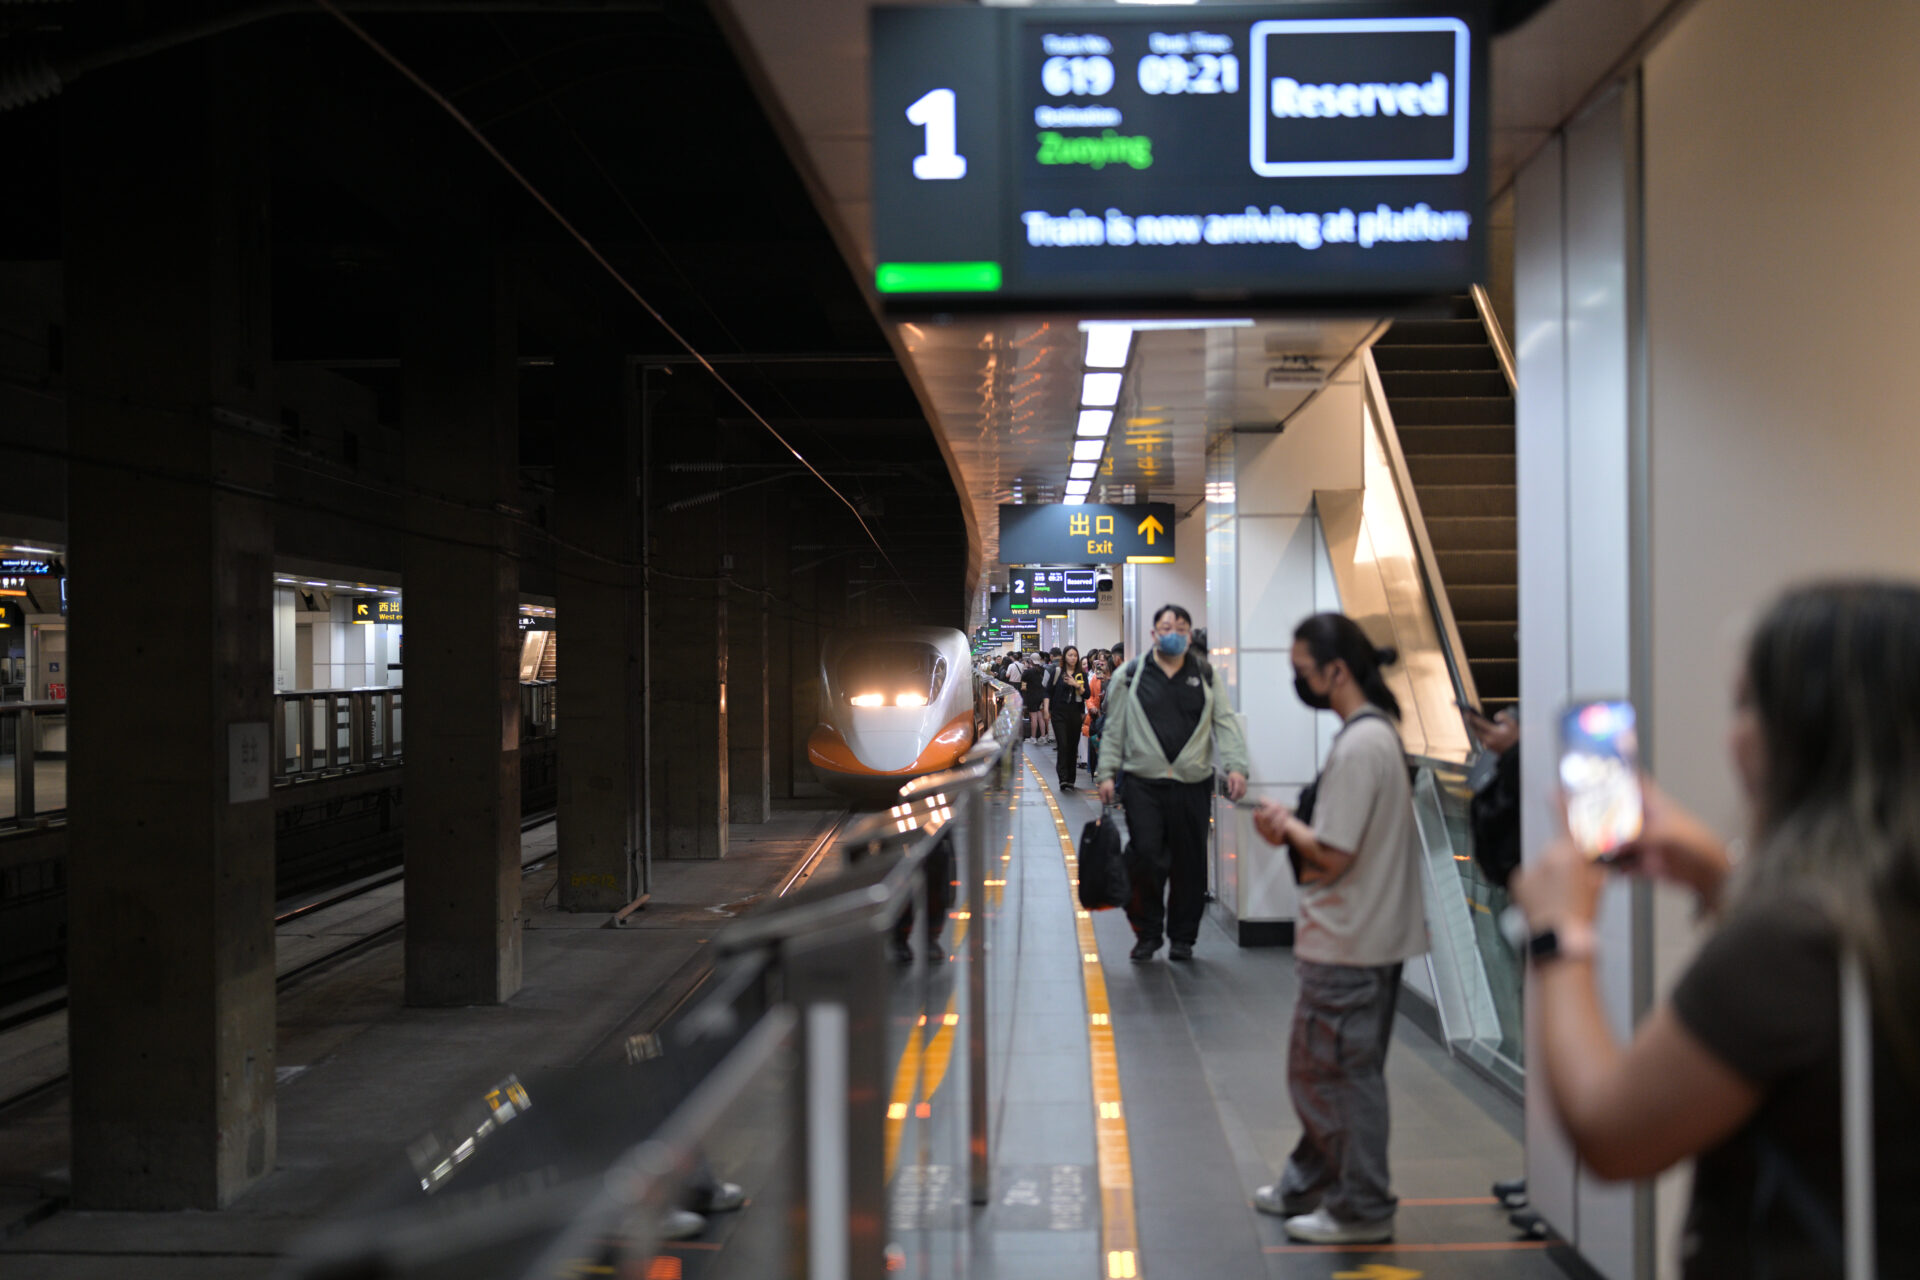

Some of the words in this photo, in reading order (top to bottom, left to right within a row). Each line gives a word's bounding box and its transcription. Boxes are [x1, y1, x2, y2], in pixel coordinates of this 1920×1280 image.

[1041, 56, 1115, 96] 619
[1271, 72, 1449, 118] Reserved
[905, 88, 967, 180] 1
[1020, 209, 1104, 247] Train
[1105, 207, 1136, 246] is
[1136, 215, 1201, 246] now
[1203, 205, 1322, 250] arriving
[1321, 207, 1357, 244] at
[1070, 512, 1114, 536] 出口
[1087, 540, 1113, 554] Exit
[1014, 579, 1025, 594] 2
[1067, 578, 1093, 586] Reserved
